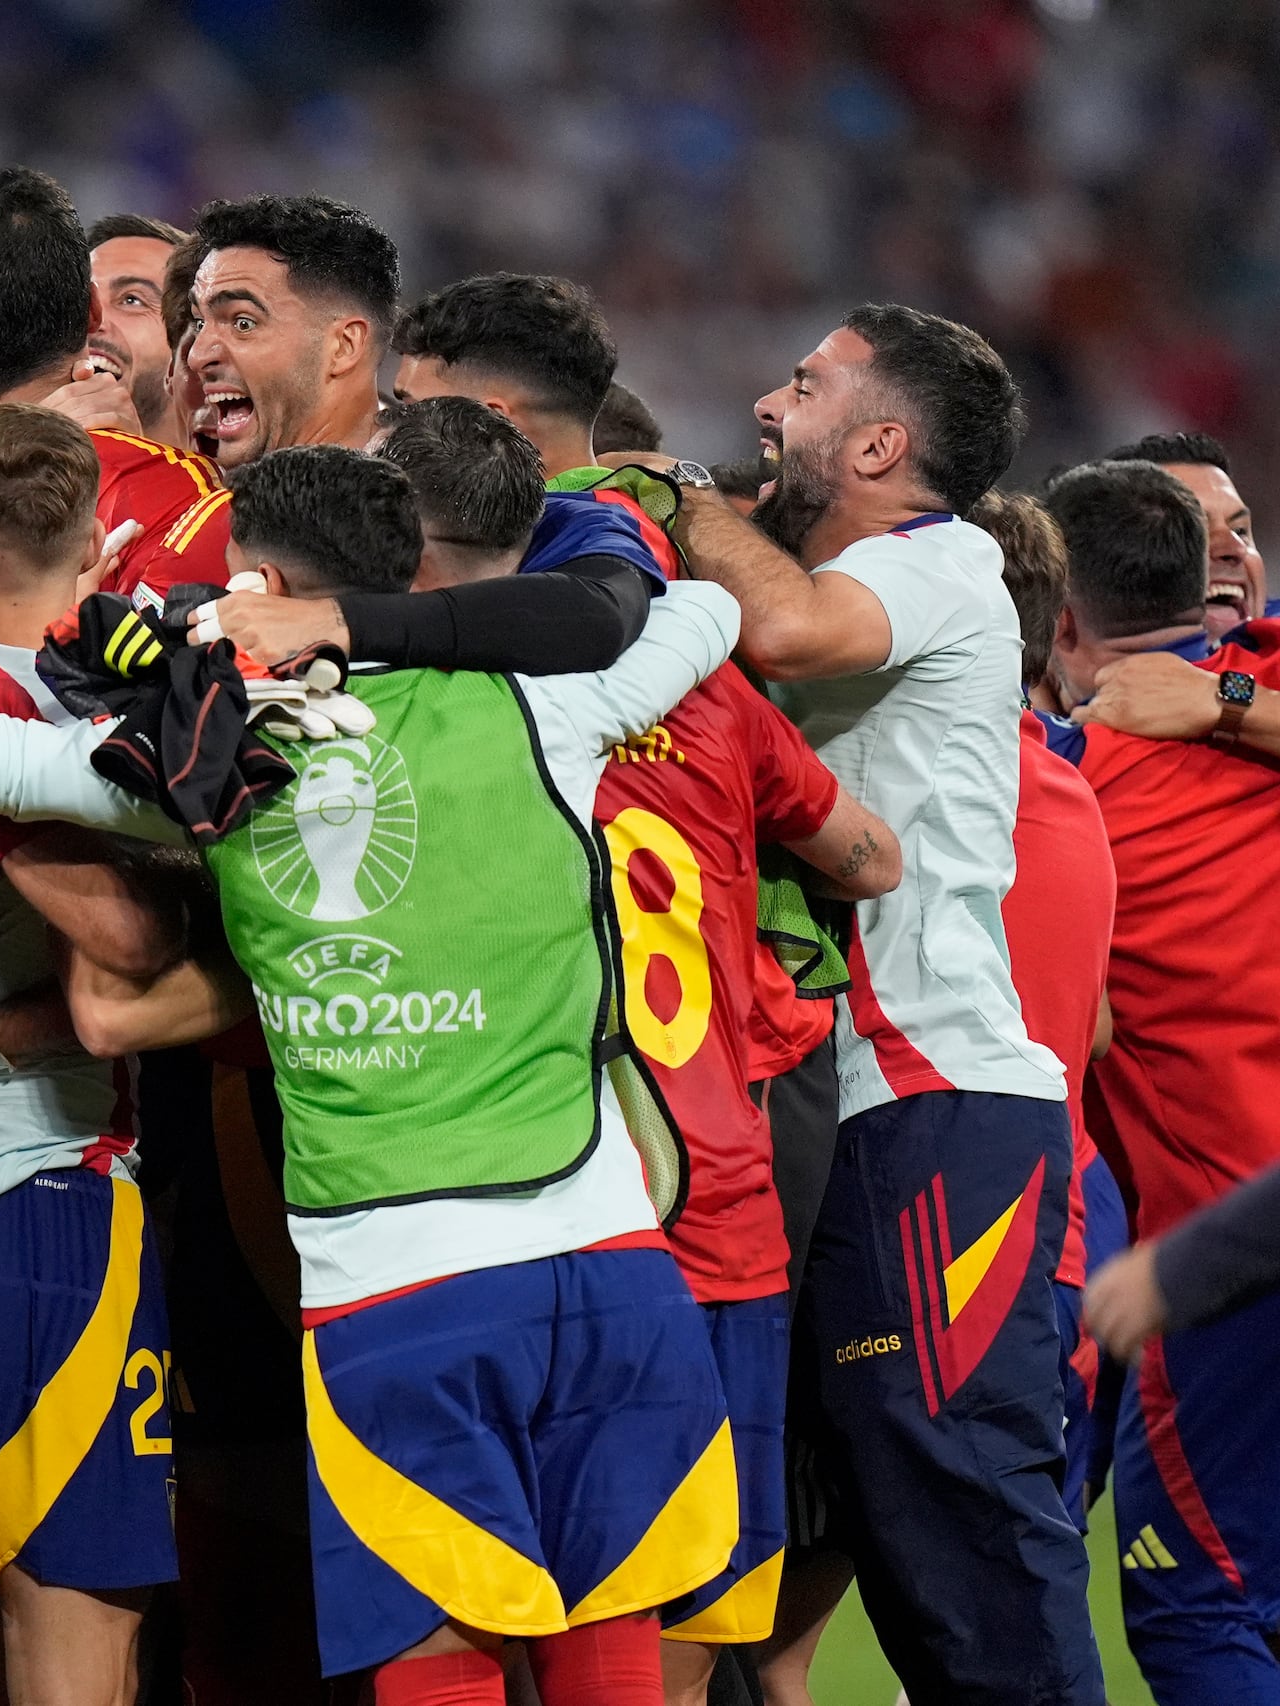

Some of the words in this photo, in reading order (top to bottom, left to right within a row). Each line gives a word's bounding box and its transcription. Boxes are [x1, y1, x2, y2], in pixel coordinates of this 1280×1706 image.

[603, 807, 713, 1069] 8
[292, 943, 391, 980] UEFA
[285, 1045, 426, 1071] GERMANY
[835, 1334, 902, 1364] adidas
